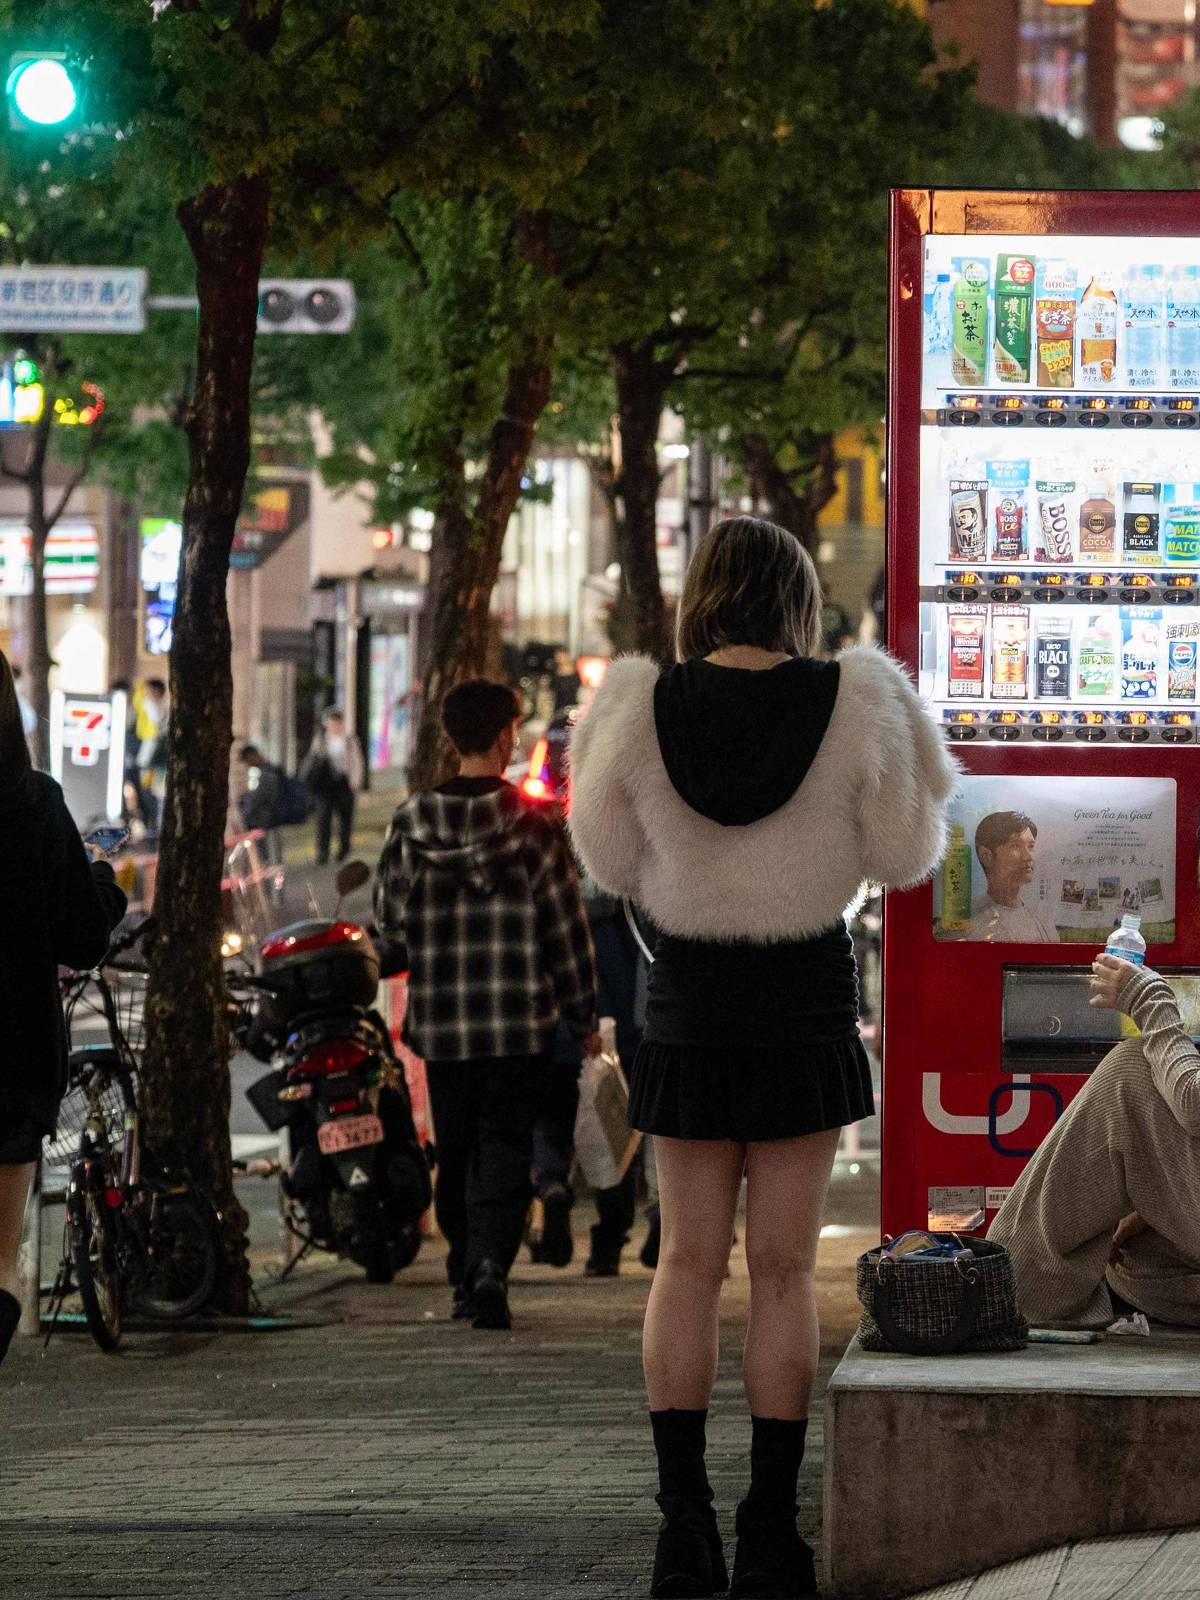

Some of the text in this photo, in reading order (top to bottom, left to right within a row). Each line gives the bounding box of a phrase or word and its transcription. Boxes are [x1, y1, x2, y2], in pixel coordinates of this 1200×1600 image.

[1049, 502, 1072, 555] BOSS
[1129, 538, 1154, 546] BLACK
[1167, 623, 1200, 639] 強刺激
[1039, 651, 1068, 664] BLACK
[1074, 809, 1099, 821] Green
[1100, 807, 1115, 819] Tea
[1129, 810, 1153, 822] Good
